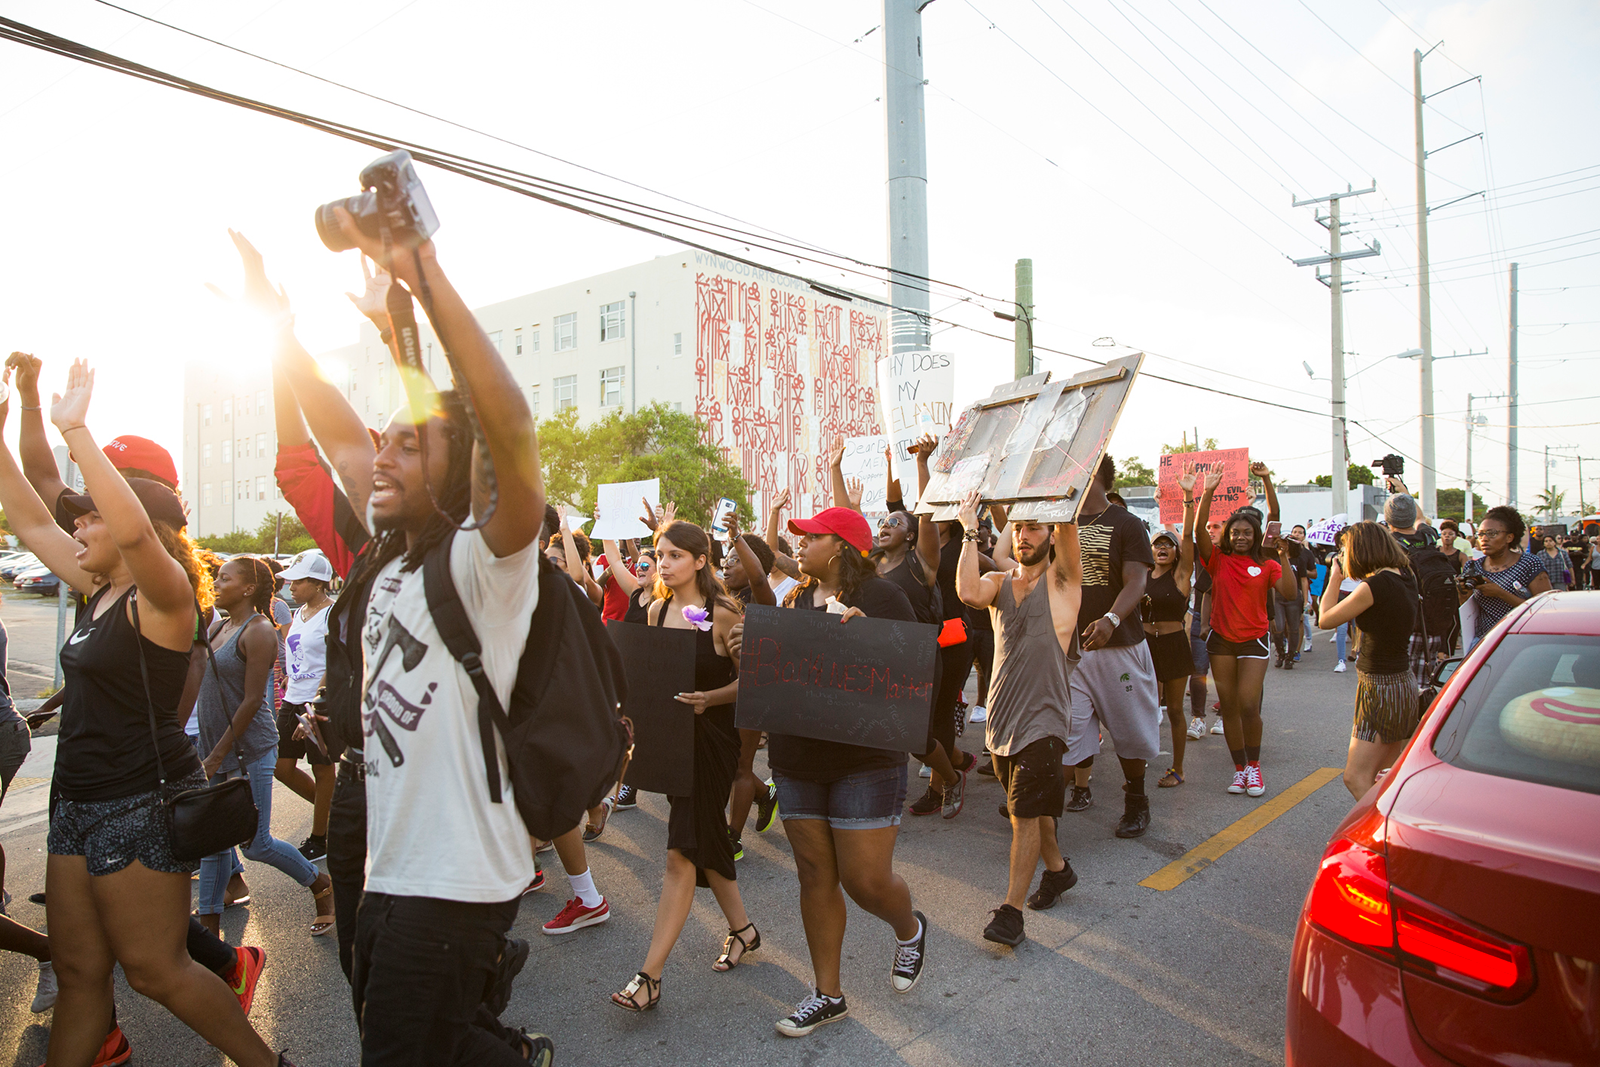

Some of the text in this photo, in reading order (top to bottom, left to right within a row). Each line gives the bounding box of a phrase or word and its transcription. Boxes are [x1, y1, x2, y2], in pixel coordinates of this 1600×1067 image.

[694, 251, 751, 277] WYNWOOD
[751, 266, 777, 284] ARTS
[889, 353, 951, 378] HY DOES
[898, 379, 921, 402] MY
[891, 401, 954, 433] ELANIN
[846, 440, 876, 458] Dear
[1160, 455, 1173, 467] HE
[857, 470, 884, 483] Support
[1226, 485, 1245, 494] EVIL
[747, 608, 782, 619] Sandra
[750, 616, 779, 626] Bland
[400, 710, 418, 726] OF
